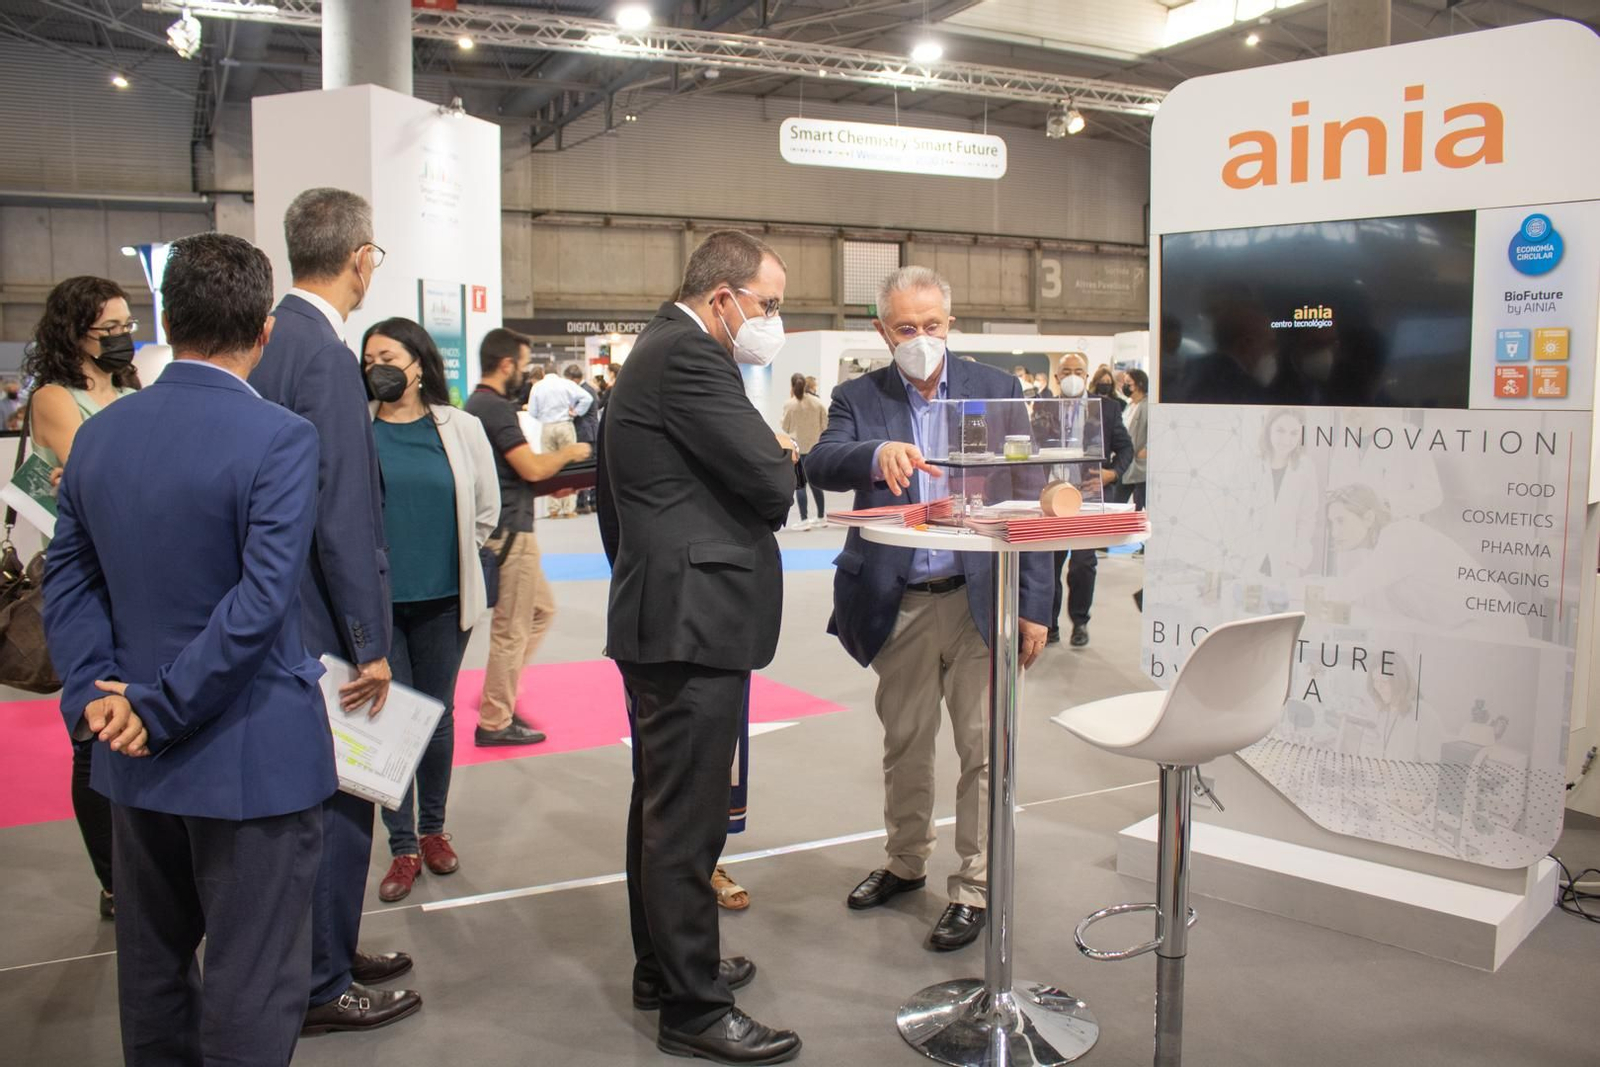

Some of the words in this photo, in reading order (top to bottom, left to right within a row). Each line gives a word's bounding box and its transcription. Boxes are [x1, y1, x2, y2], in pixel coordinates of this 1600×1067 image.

[790, 126, 834, 143] Smart
[837, 130, 908, 151] Chemistry
[912, 138, 952, 154] Smart
[956, 141, 999, 157] Future
[1221, 84, 1505, 190] ainia
[1516, 244, 1555, 254] ECONOMÍA
[1516, 252, 1554, 261] CIRCULAR
[1041, 259, 1062, 298] 3
[1504, 290, 1563, 302] BioFuture
[1294, 305, 1332, 319] ainia
[1507, 304, 1521, 316] by
[1523, 302, 1557, 313] AINIA
[567, 322, 602, 333] DIGITAL
[617, 323, 647, 333] EXPER
[1294, 319, 1333, 329] tecnológico
[1301, 425, 1556, 455] INNOVATION
[1507, 482, 1556, 498] FOOD
[1462, 509, 1554, 528] COSMETICS
[1481, 539, 1552, 558] PHARMA
[1457, 567, 1550, 588] PACKAGING
[1465, 596, 1548, 618] CHEMICAL
